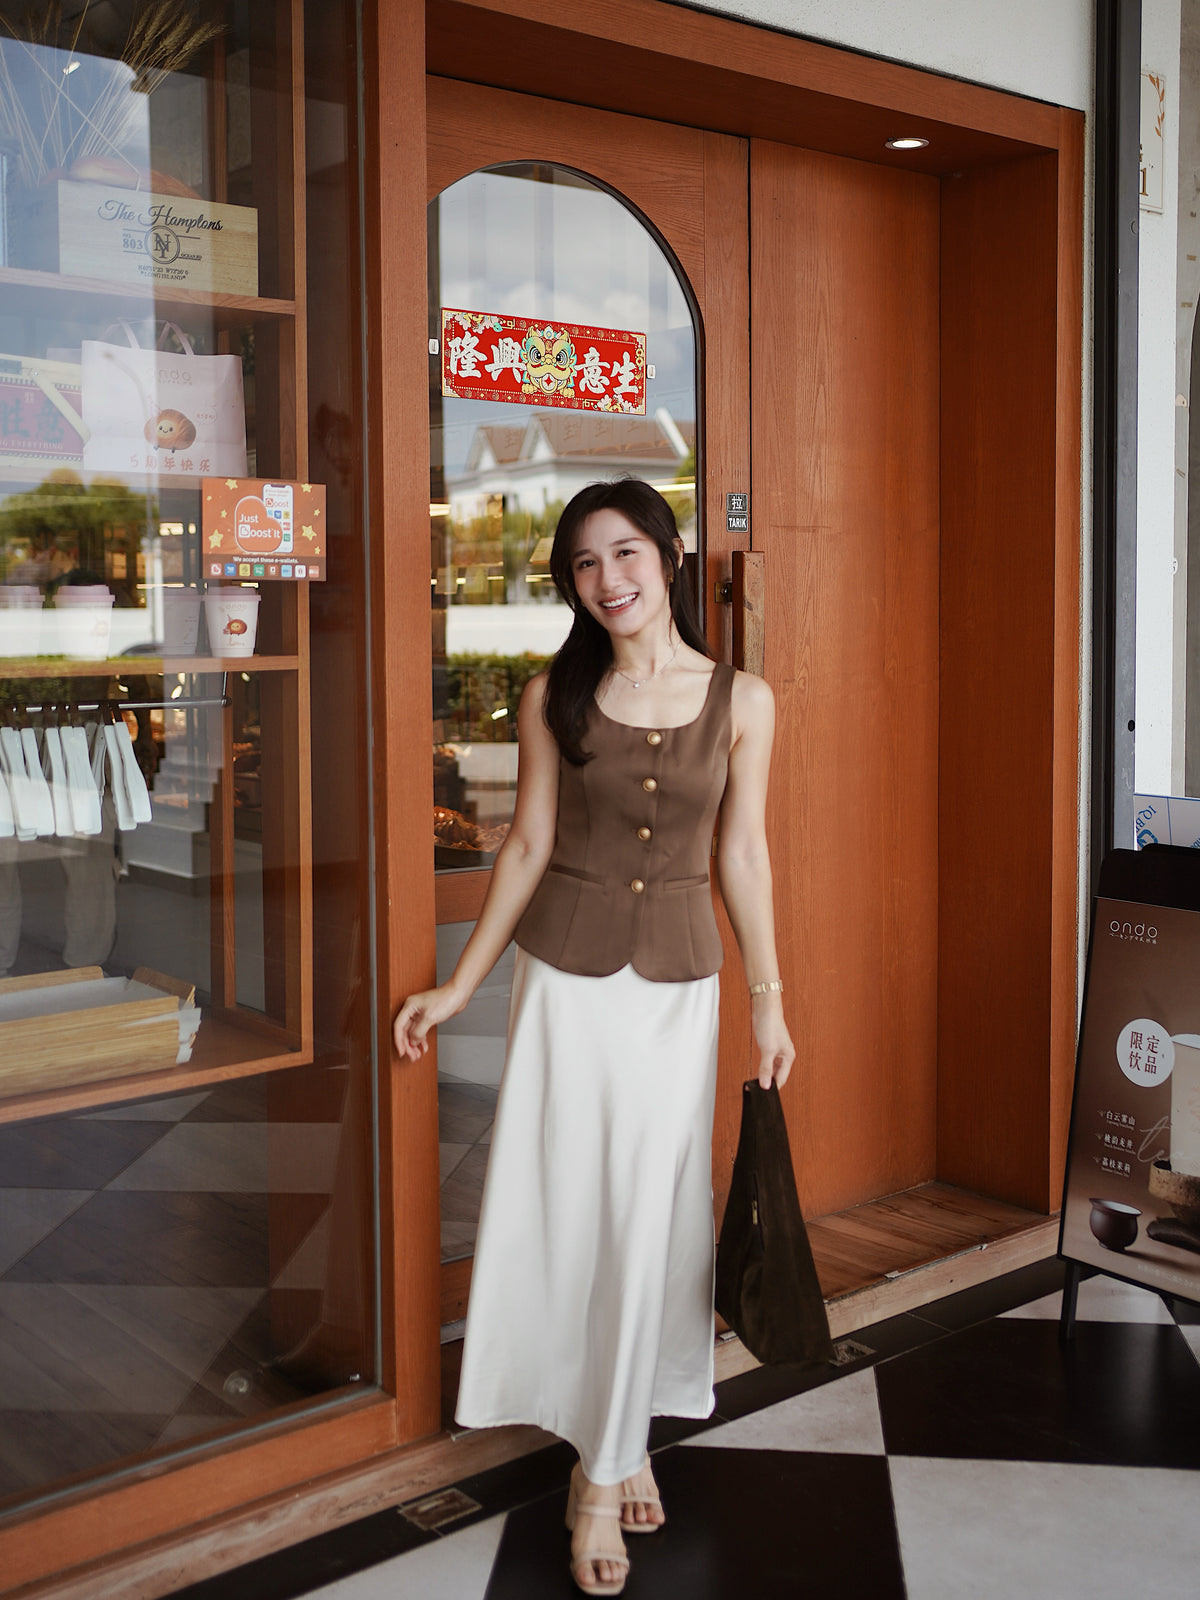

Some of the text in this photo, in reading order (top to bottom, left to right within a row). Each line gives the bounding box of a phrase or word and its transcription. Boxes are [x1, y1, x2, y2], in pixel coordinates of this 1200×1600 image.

[98, 200, 223, 233] The Hamptons
[122, 238, 144, 250] 803
[731, 495, 743, 510] 拉
[239, 514, 259, 523] Just
[728, 517, 747, 528] TARIK
[1109, 920, 1158, 939] ondo
[1130, 1030, 1160, 1054] 限定
[1128, 1050, 1157, 1074] 饮品
